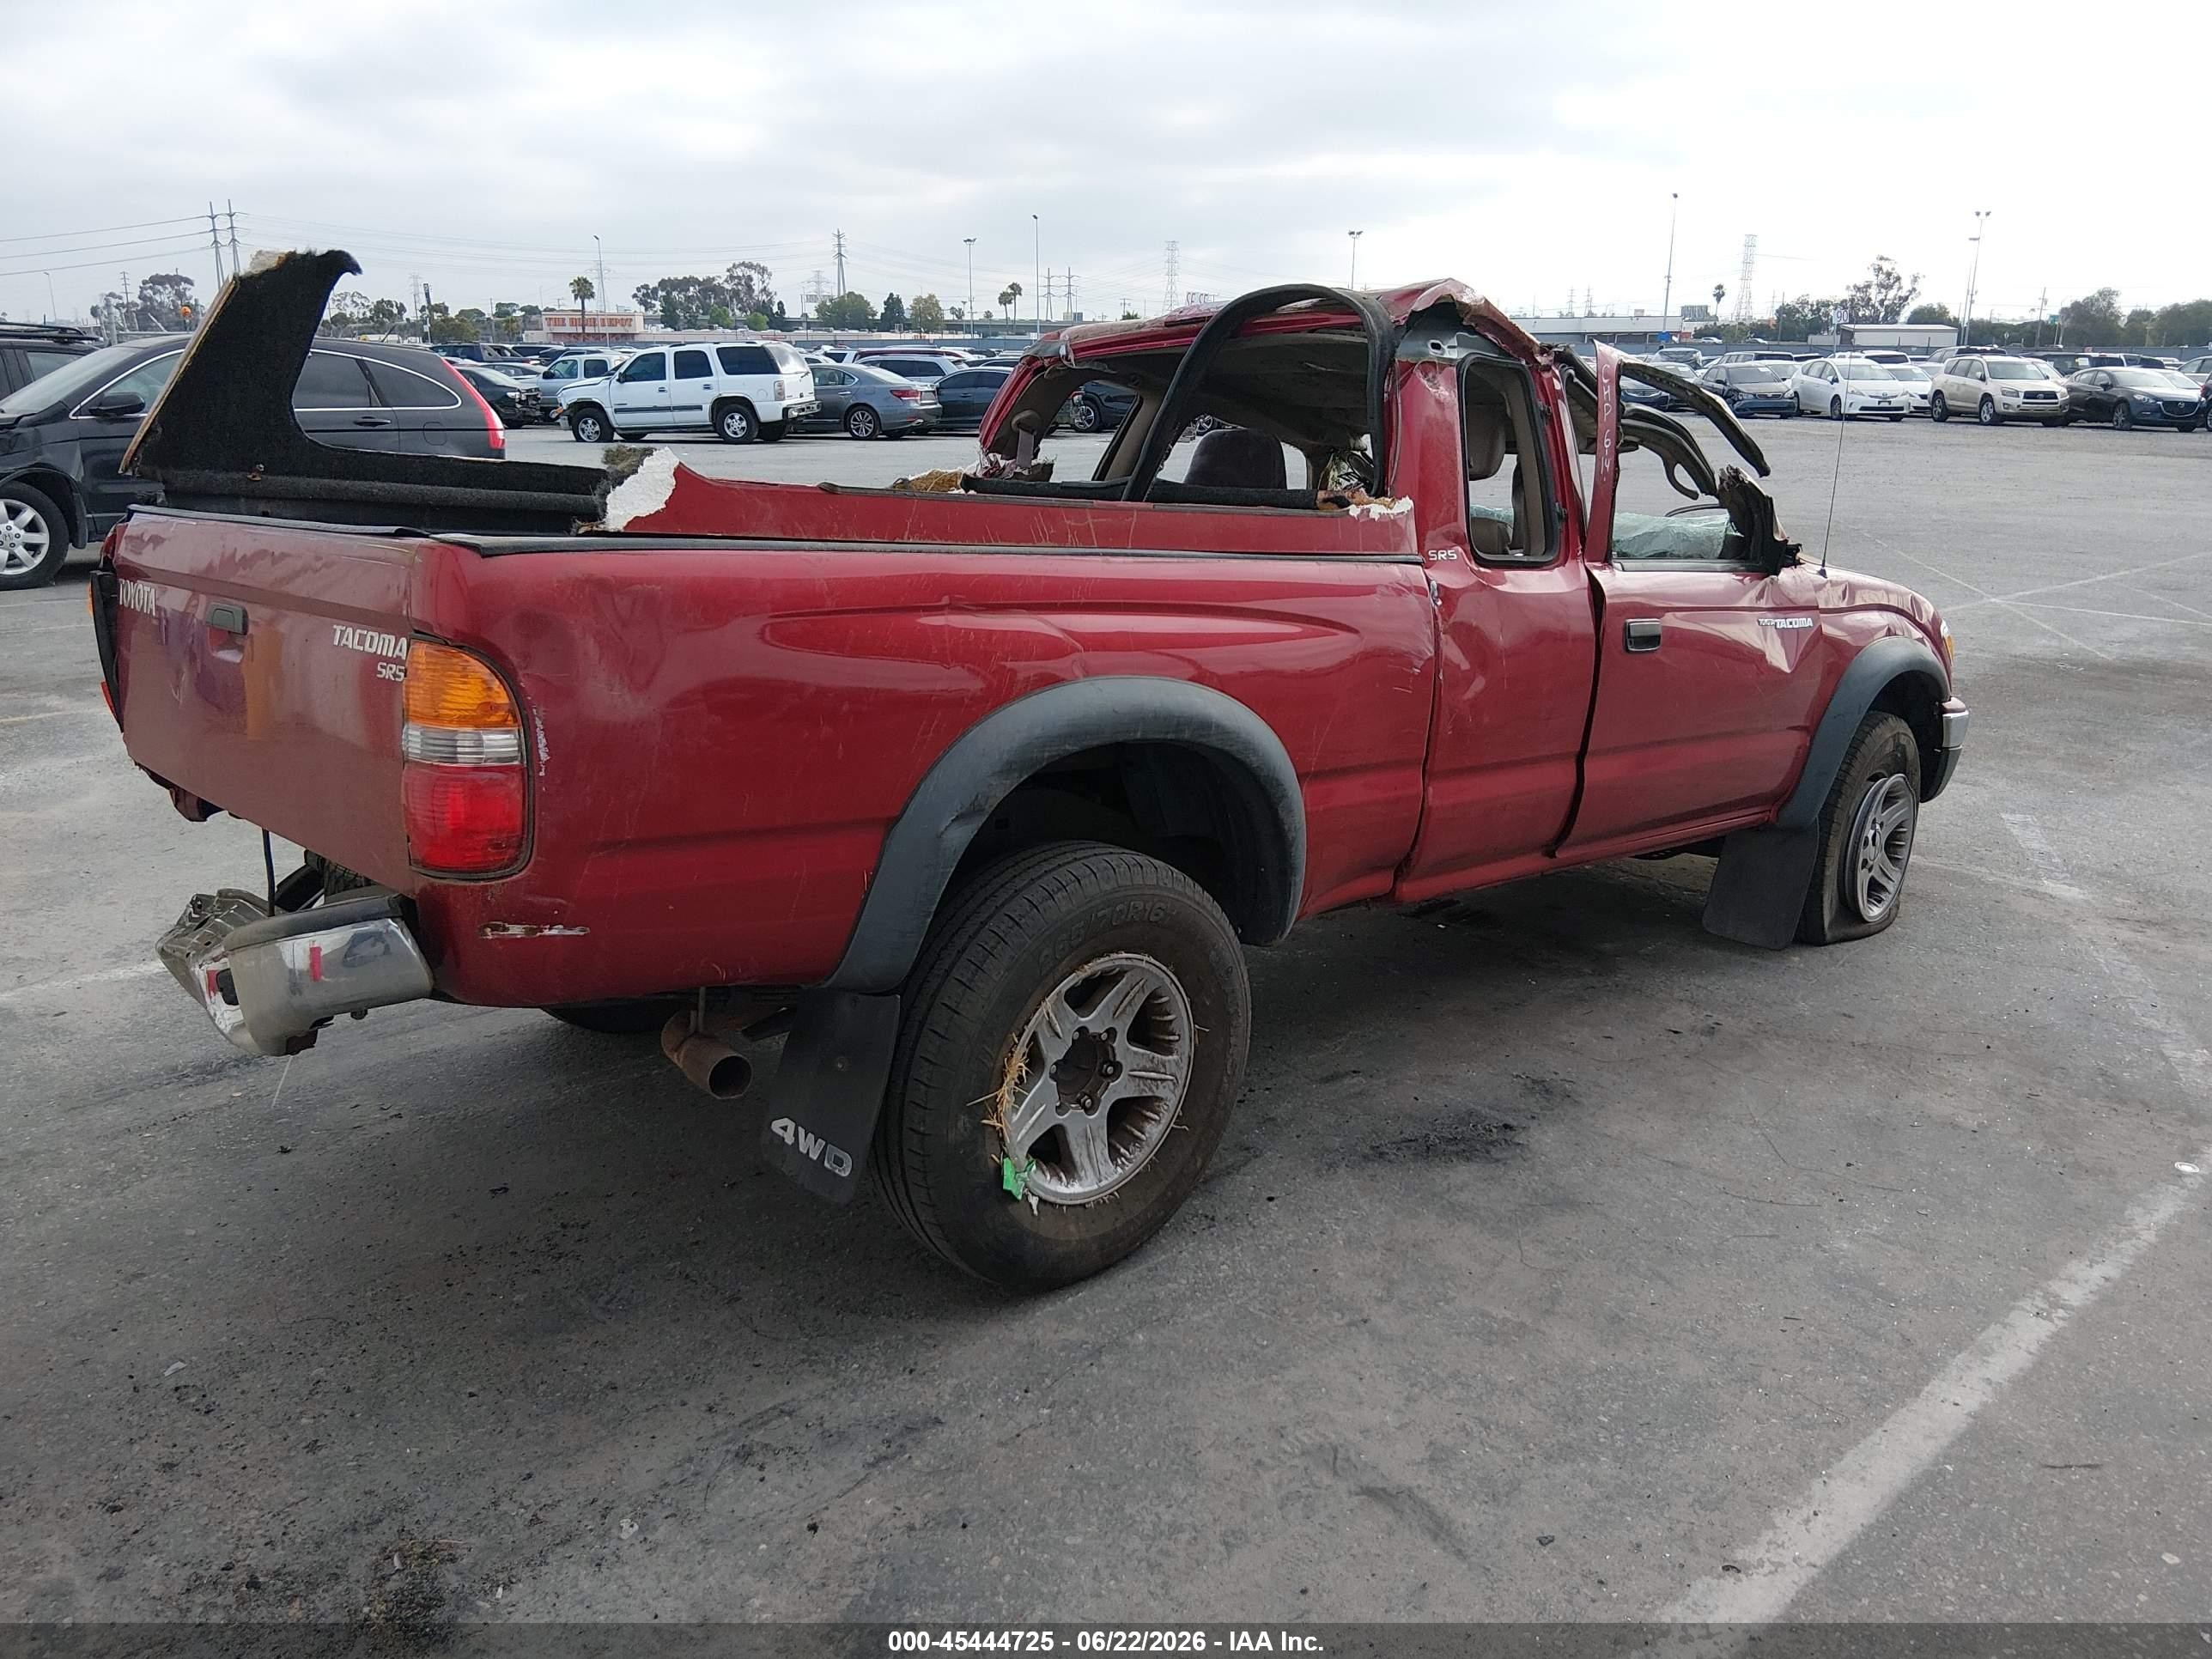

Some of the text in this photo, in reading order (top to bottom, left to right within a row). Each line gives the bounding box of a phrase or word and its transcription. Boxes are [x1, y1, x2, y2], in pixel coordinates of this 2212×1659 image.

[1836, 310, 1849, 322] 90
[118, 578, 155, 617] TOYOTA
[1775, 618, 1814, 629] TACOMA
[332, 624, 407, 660] TACOMA
[770, 1117, 853, 1177] 4WD
